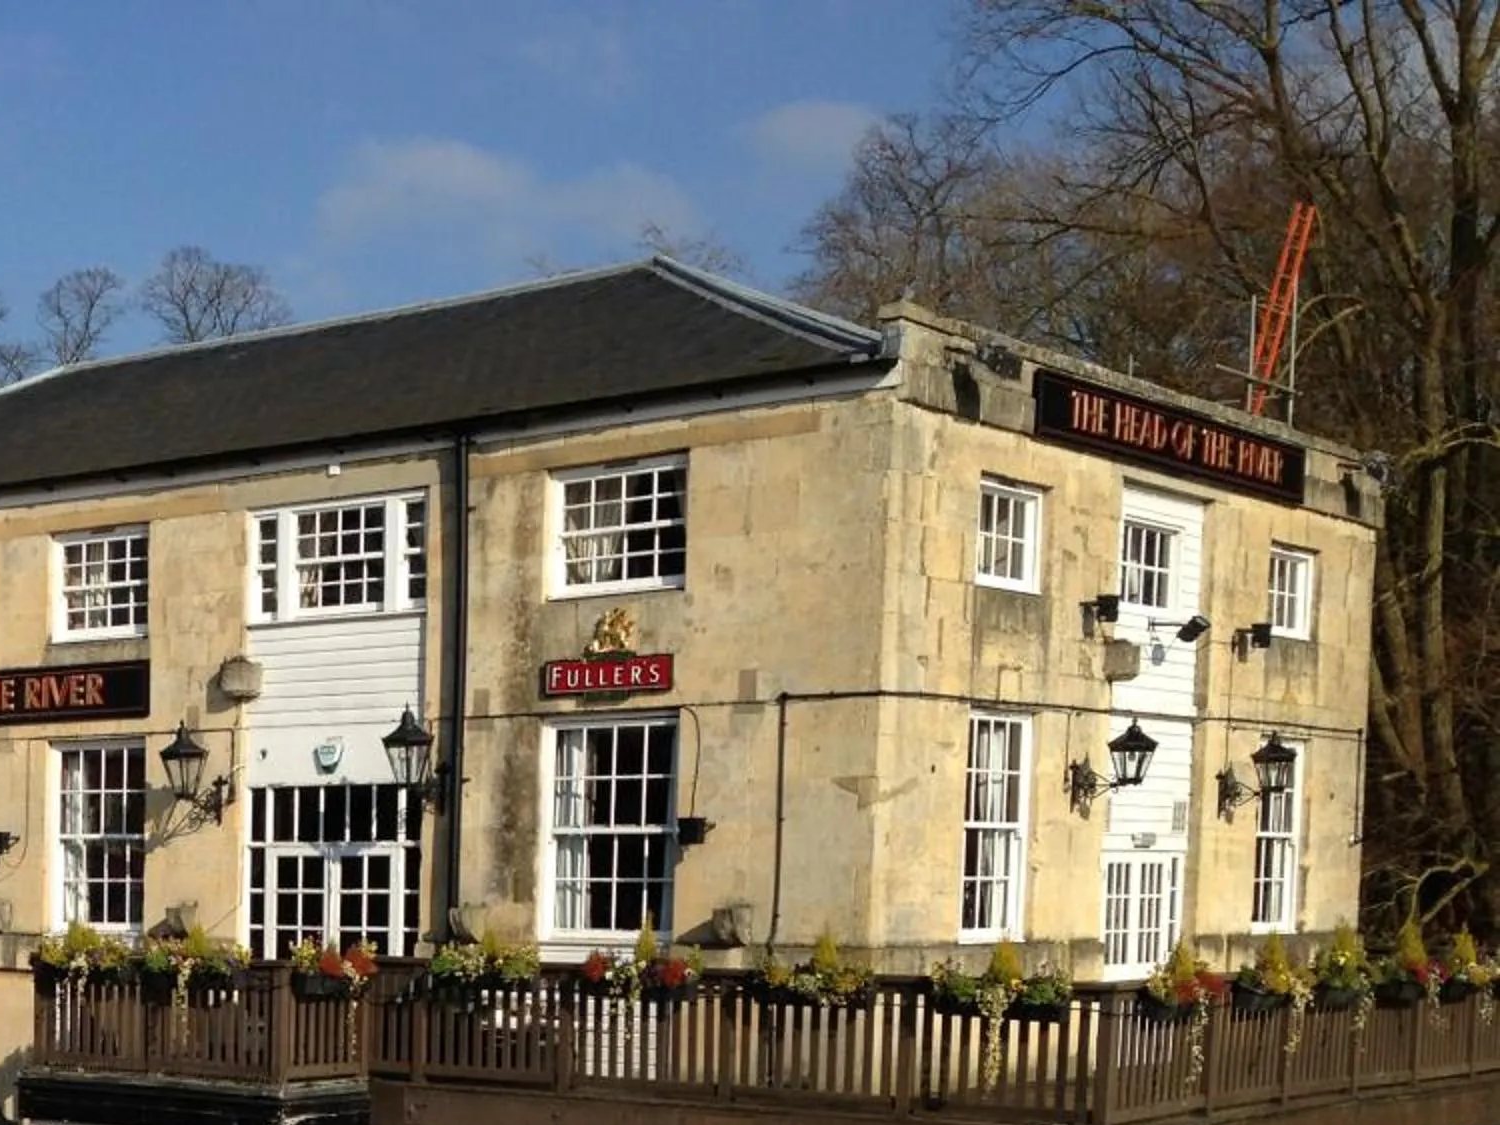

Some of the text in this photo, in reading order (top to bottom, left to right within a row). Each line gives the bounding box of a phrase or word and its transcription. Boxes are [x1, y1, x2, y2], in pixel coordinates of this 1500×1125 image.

[1071, 389, 1109, 434] THE
[1114, 401, 1168, 450] HEAD
[1171, 421, 1197, 461] OF
[1202, 429, 1233, 469] THE
[24, 673, 105, 709] RIVER
